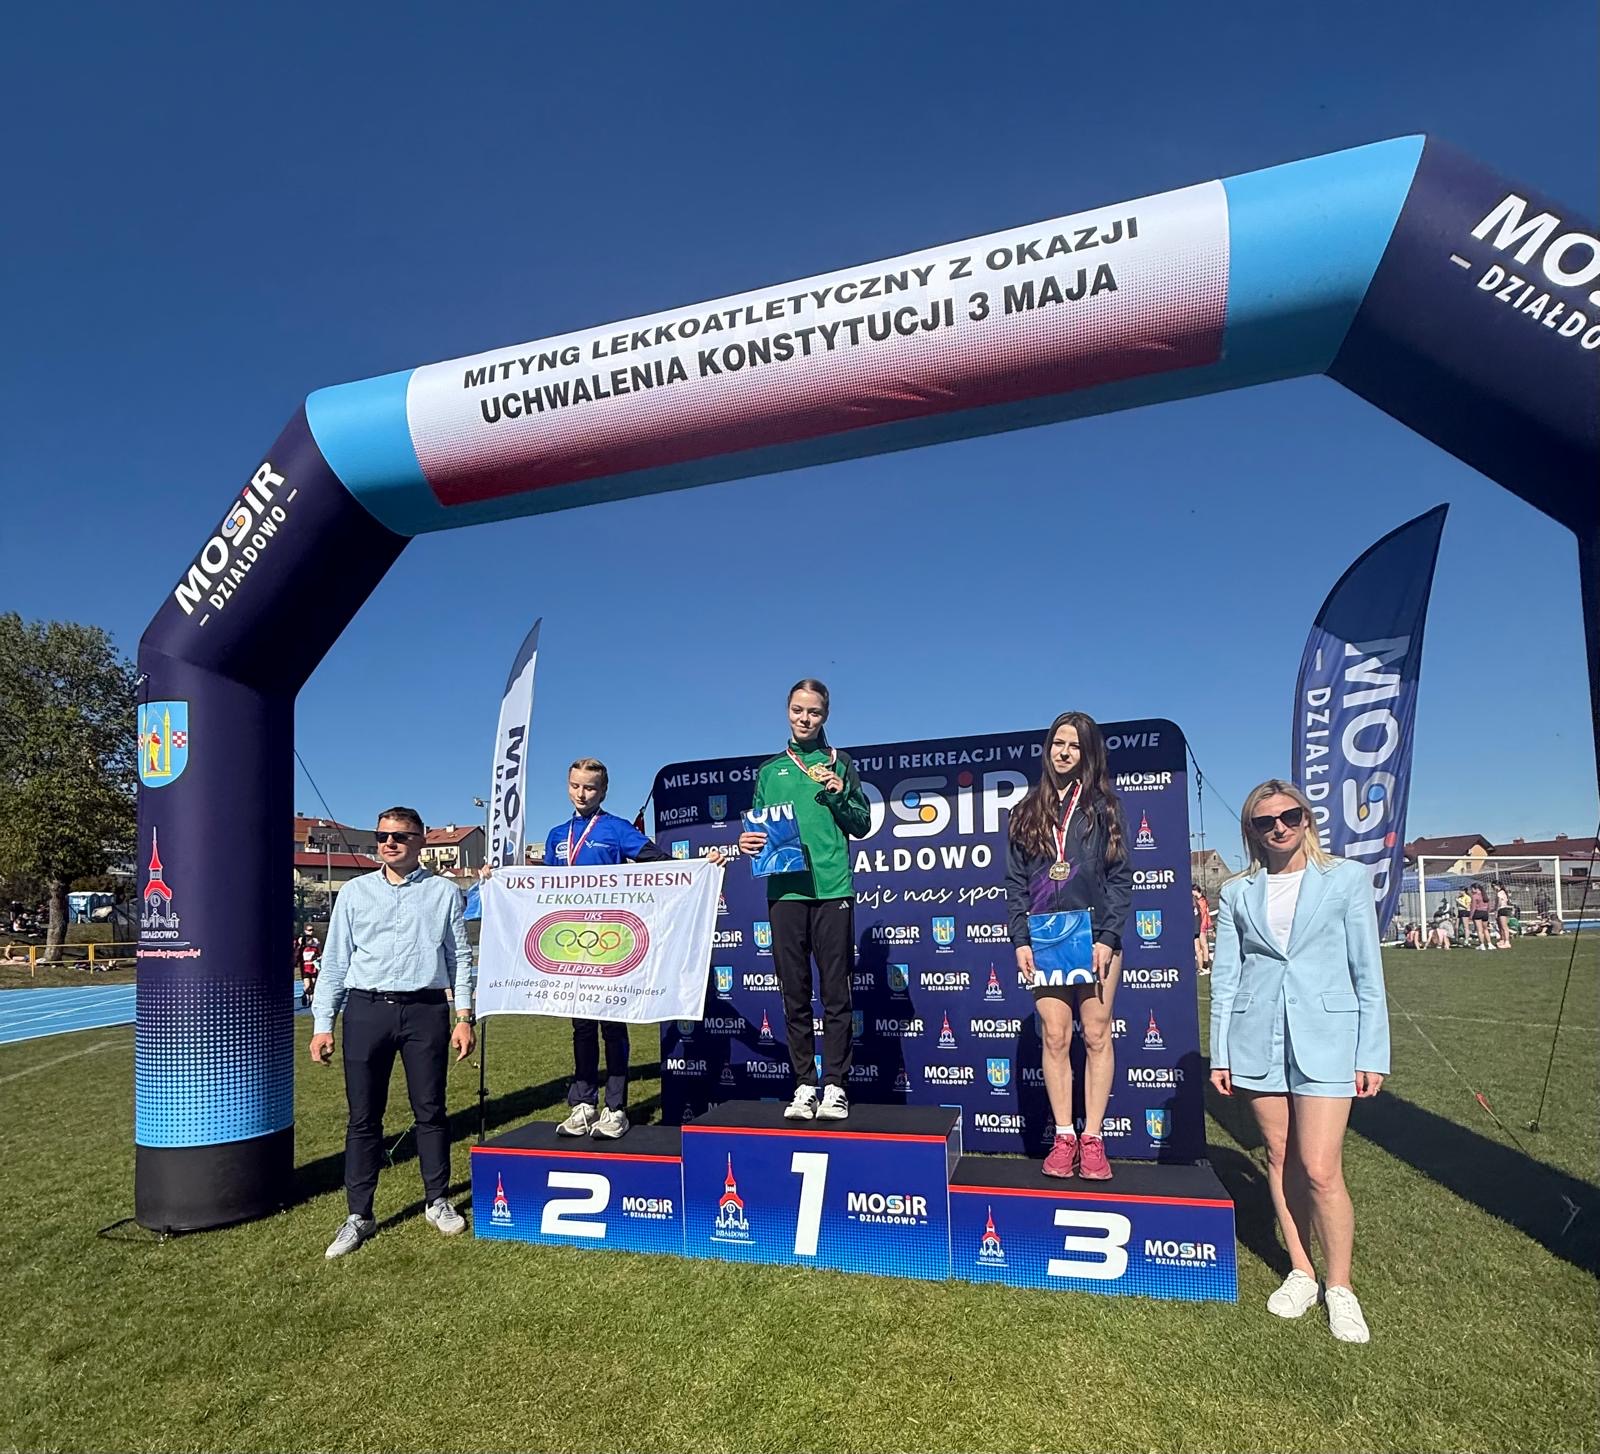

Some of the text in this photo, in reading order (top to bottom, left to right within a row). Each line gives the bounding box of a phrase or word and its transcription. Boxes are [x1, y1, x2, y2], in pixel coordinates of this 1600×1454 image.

[464, 216, 1138, 389] MITYNG LEKKOATLETYCZNY Z OKAZJI
[1477, 264, 1600, 350] DZIAŁDO
[481, 263, 1118, 423] UCHWALENIA KONSTYTUCJI 3 MAJA
[174, 462, 285, 616] MOSiR
[209, 506, 287, 611] DZIAŁDOWO
[664, 771, 724, 790] MIEJSKI
[889, 757, 893, 769] I
[900, 747, 1000, 769] REKREACJI
[1007, 745, 1024, 759] W
[1116, 771, 1171, 786] MOSiR
[660, 805, 698, 822] MOSiR
[854, 845, 992, 873] AŁDOWO
[506, 871, 692, 889] UKS FILIPIDES TERESIN
[1132, 870, 1175, 884] OSiR
[536, 892, 655, 905] LEKKOATLETYKA
[903, 887, 953, 902] nas
[957, 887, 1008, 906] spor
[583, 912, 603, 921] UKS
[712, 930, 743, 943] OSiR
[872, 924, 1008, 939] MOSiR MOSi
[558, 963, 604, 974] FILIPIDES
[920, 972, 970, 986] MOSiR
[1122, 969, 1179, 983] MOSiR
[489, 978, 574, 989] uks.filipides@o2.pl
[743, 974, 778, 986] MOSi
[526, 990, 627, 1006] +48 609 042 699
[704, 1017, 746, 1029] MOSiR
[876, 1018, 924, 1031] MOSiR
[971, 1019, 1022, 1032] MOSiR
[667, 1058, 707, 1071] MOSiR
[747, 1061, 790, 1074] MOSiR
[924, 1065, 974, 1079] MOSiR
[1128, 1068, 1184, 1082] MOSiR
[975, 1113, 1026, 1128] MOSiR
[540, 1171, 611, 1239] 2
[623, 1196, 673, 1214] MOSiR
[791, 1151, 829, 1256] 1
[848, 1192, 927, 1216] MOSiR
[860, 1214, 917, 1225] DZIAŁDOWO
[1047, 1209, 1132, 1280] 3
[1145, 1240, 1217, 1260] MOSiR
